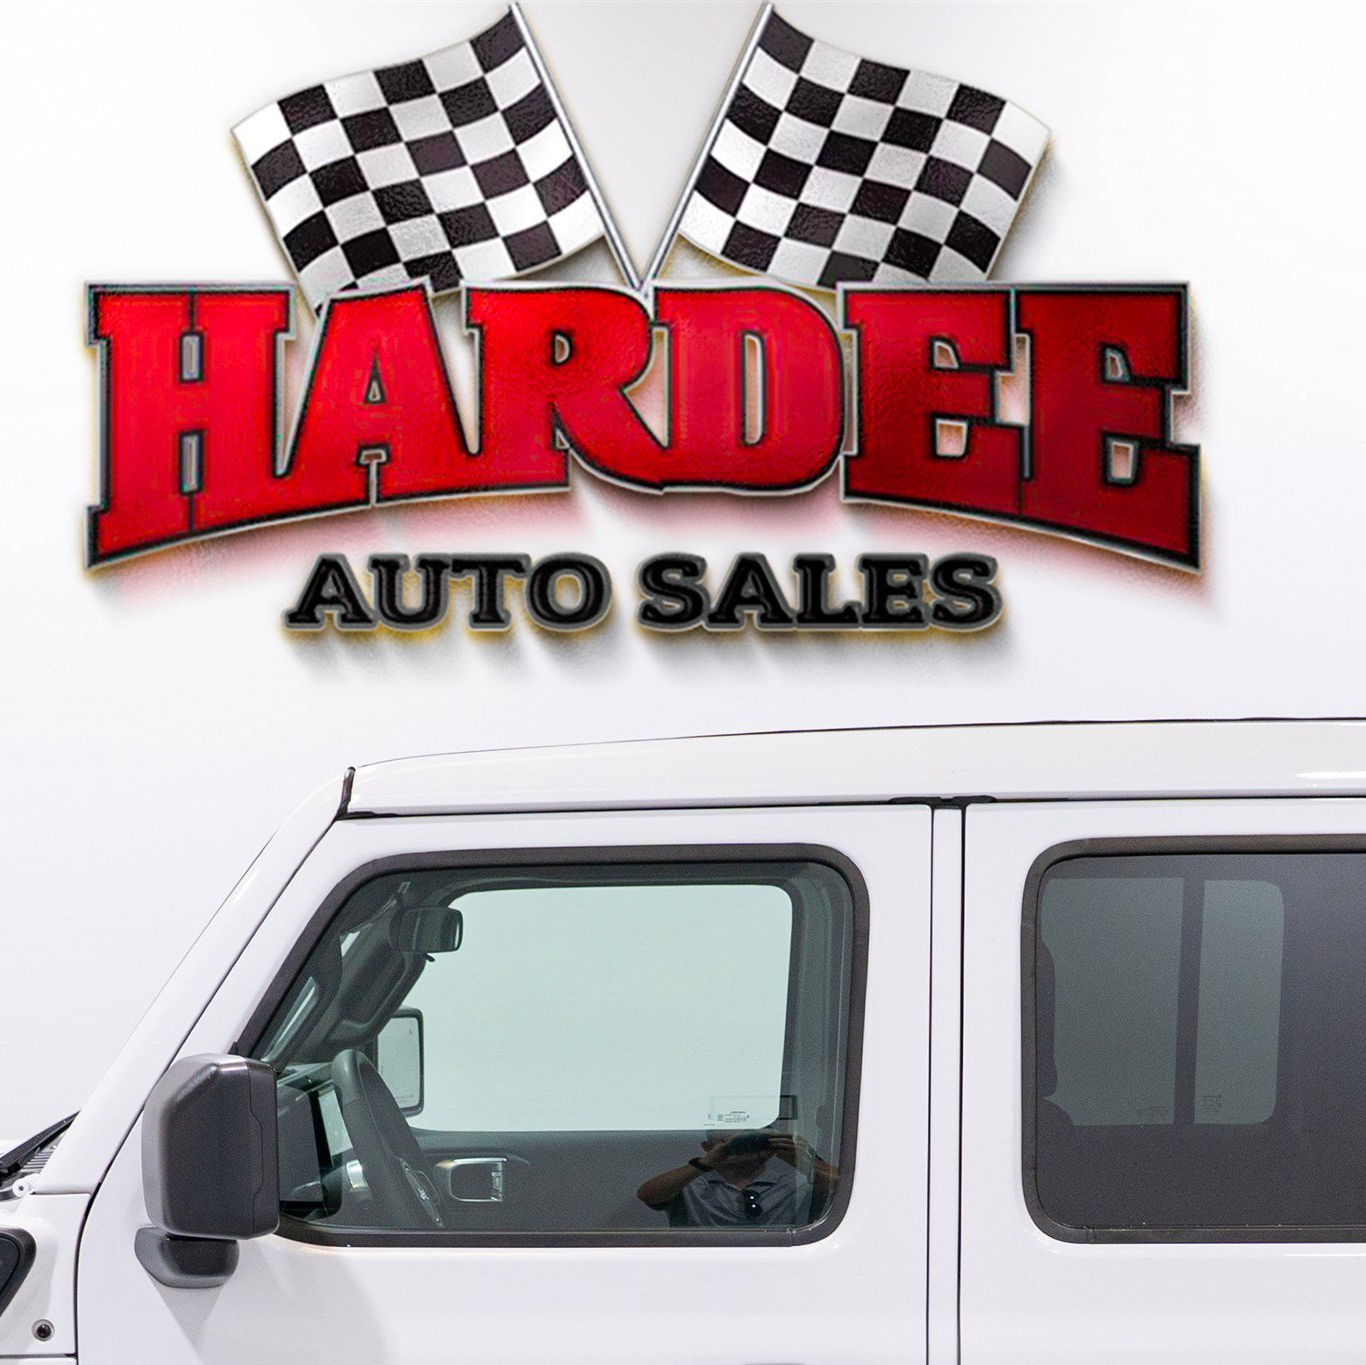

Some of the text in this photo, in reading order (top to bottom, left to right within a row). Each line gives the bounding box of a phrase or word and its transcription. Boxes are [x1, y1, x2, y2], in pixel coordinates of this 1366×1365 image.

[84, 282, 1202, 572] HARDEE
[282, 553, 1005, 631] AUTO SALES
